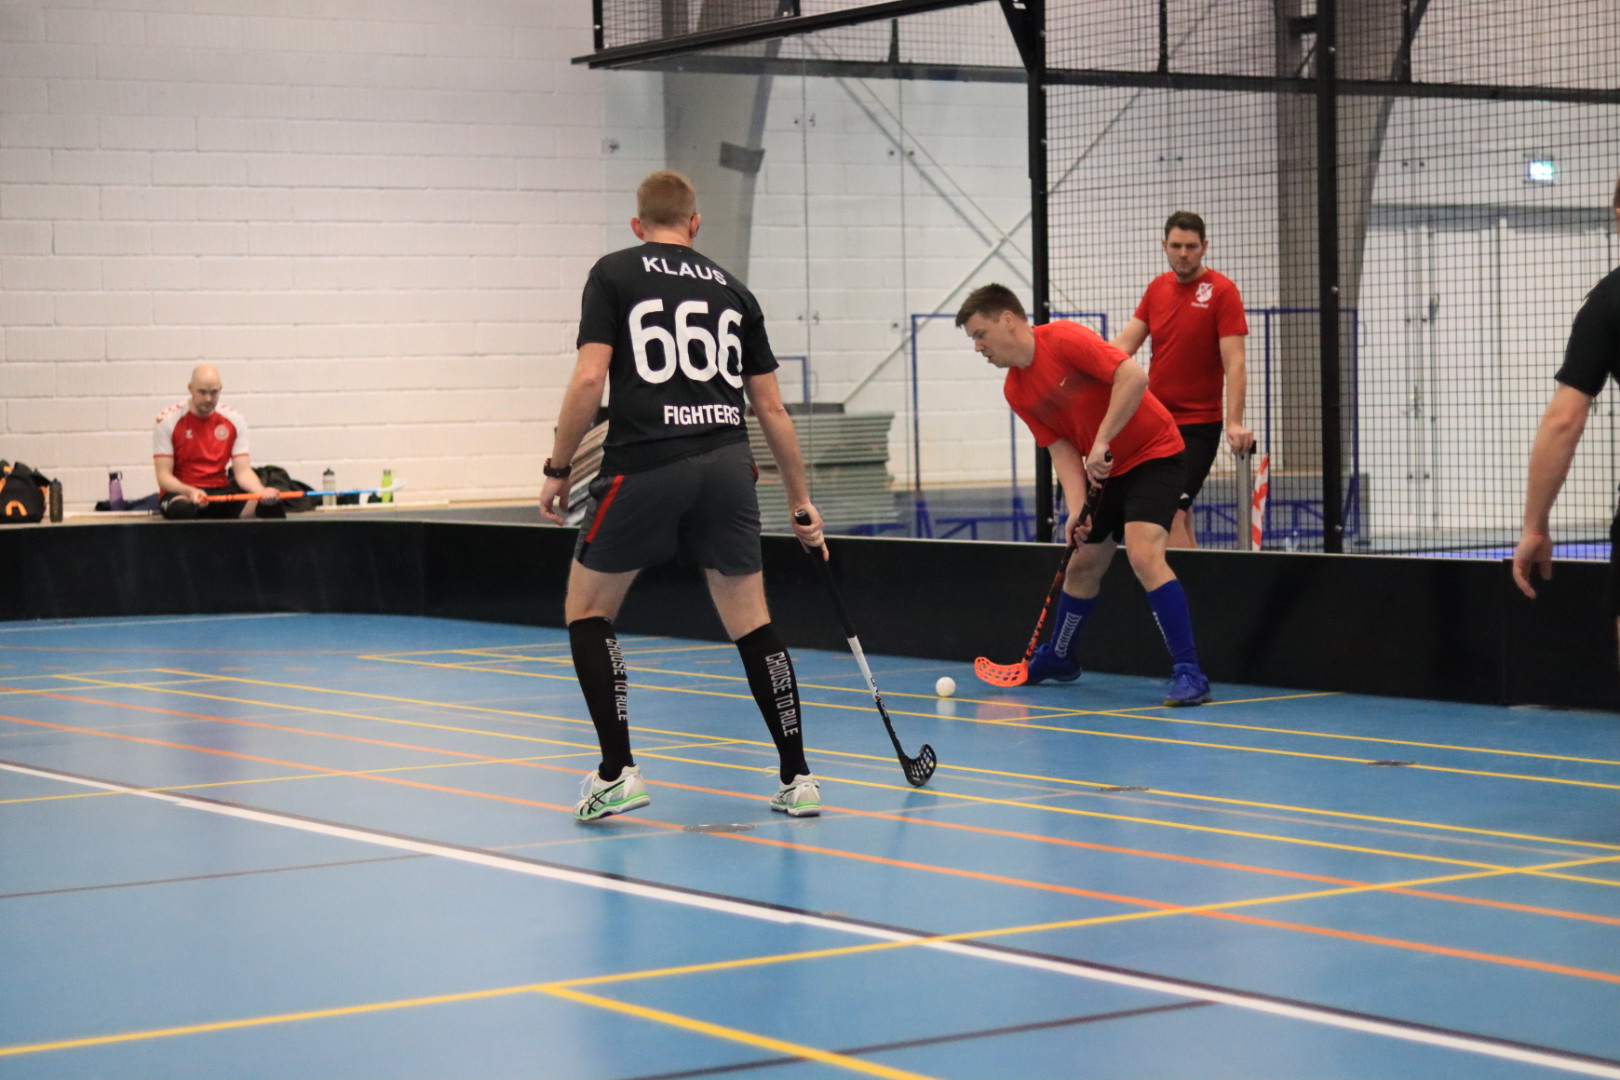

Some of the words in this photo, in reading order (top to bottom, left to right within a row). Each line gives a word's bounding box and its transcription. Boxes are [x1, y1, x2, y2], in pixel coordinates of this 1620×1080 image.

[641, 256, 727, 285] KLAUS
[628, 298, 744, 389] 666
[663, 404, 741, 426] FIGHTERS
[765, 651, 792, 694] CHOOSE
[615, 694, 628, 721] RULE
[774, 692, 795, 710] TO
[779, 708, 799, 738] RULE
